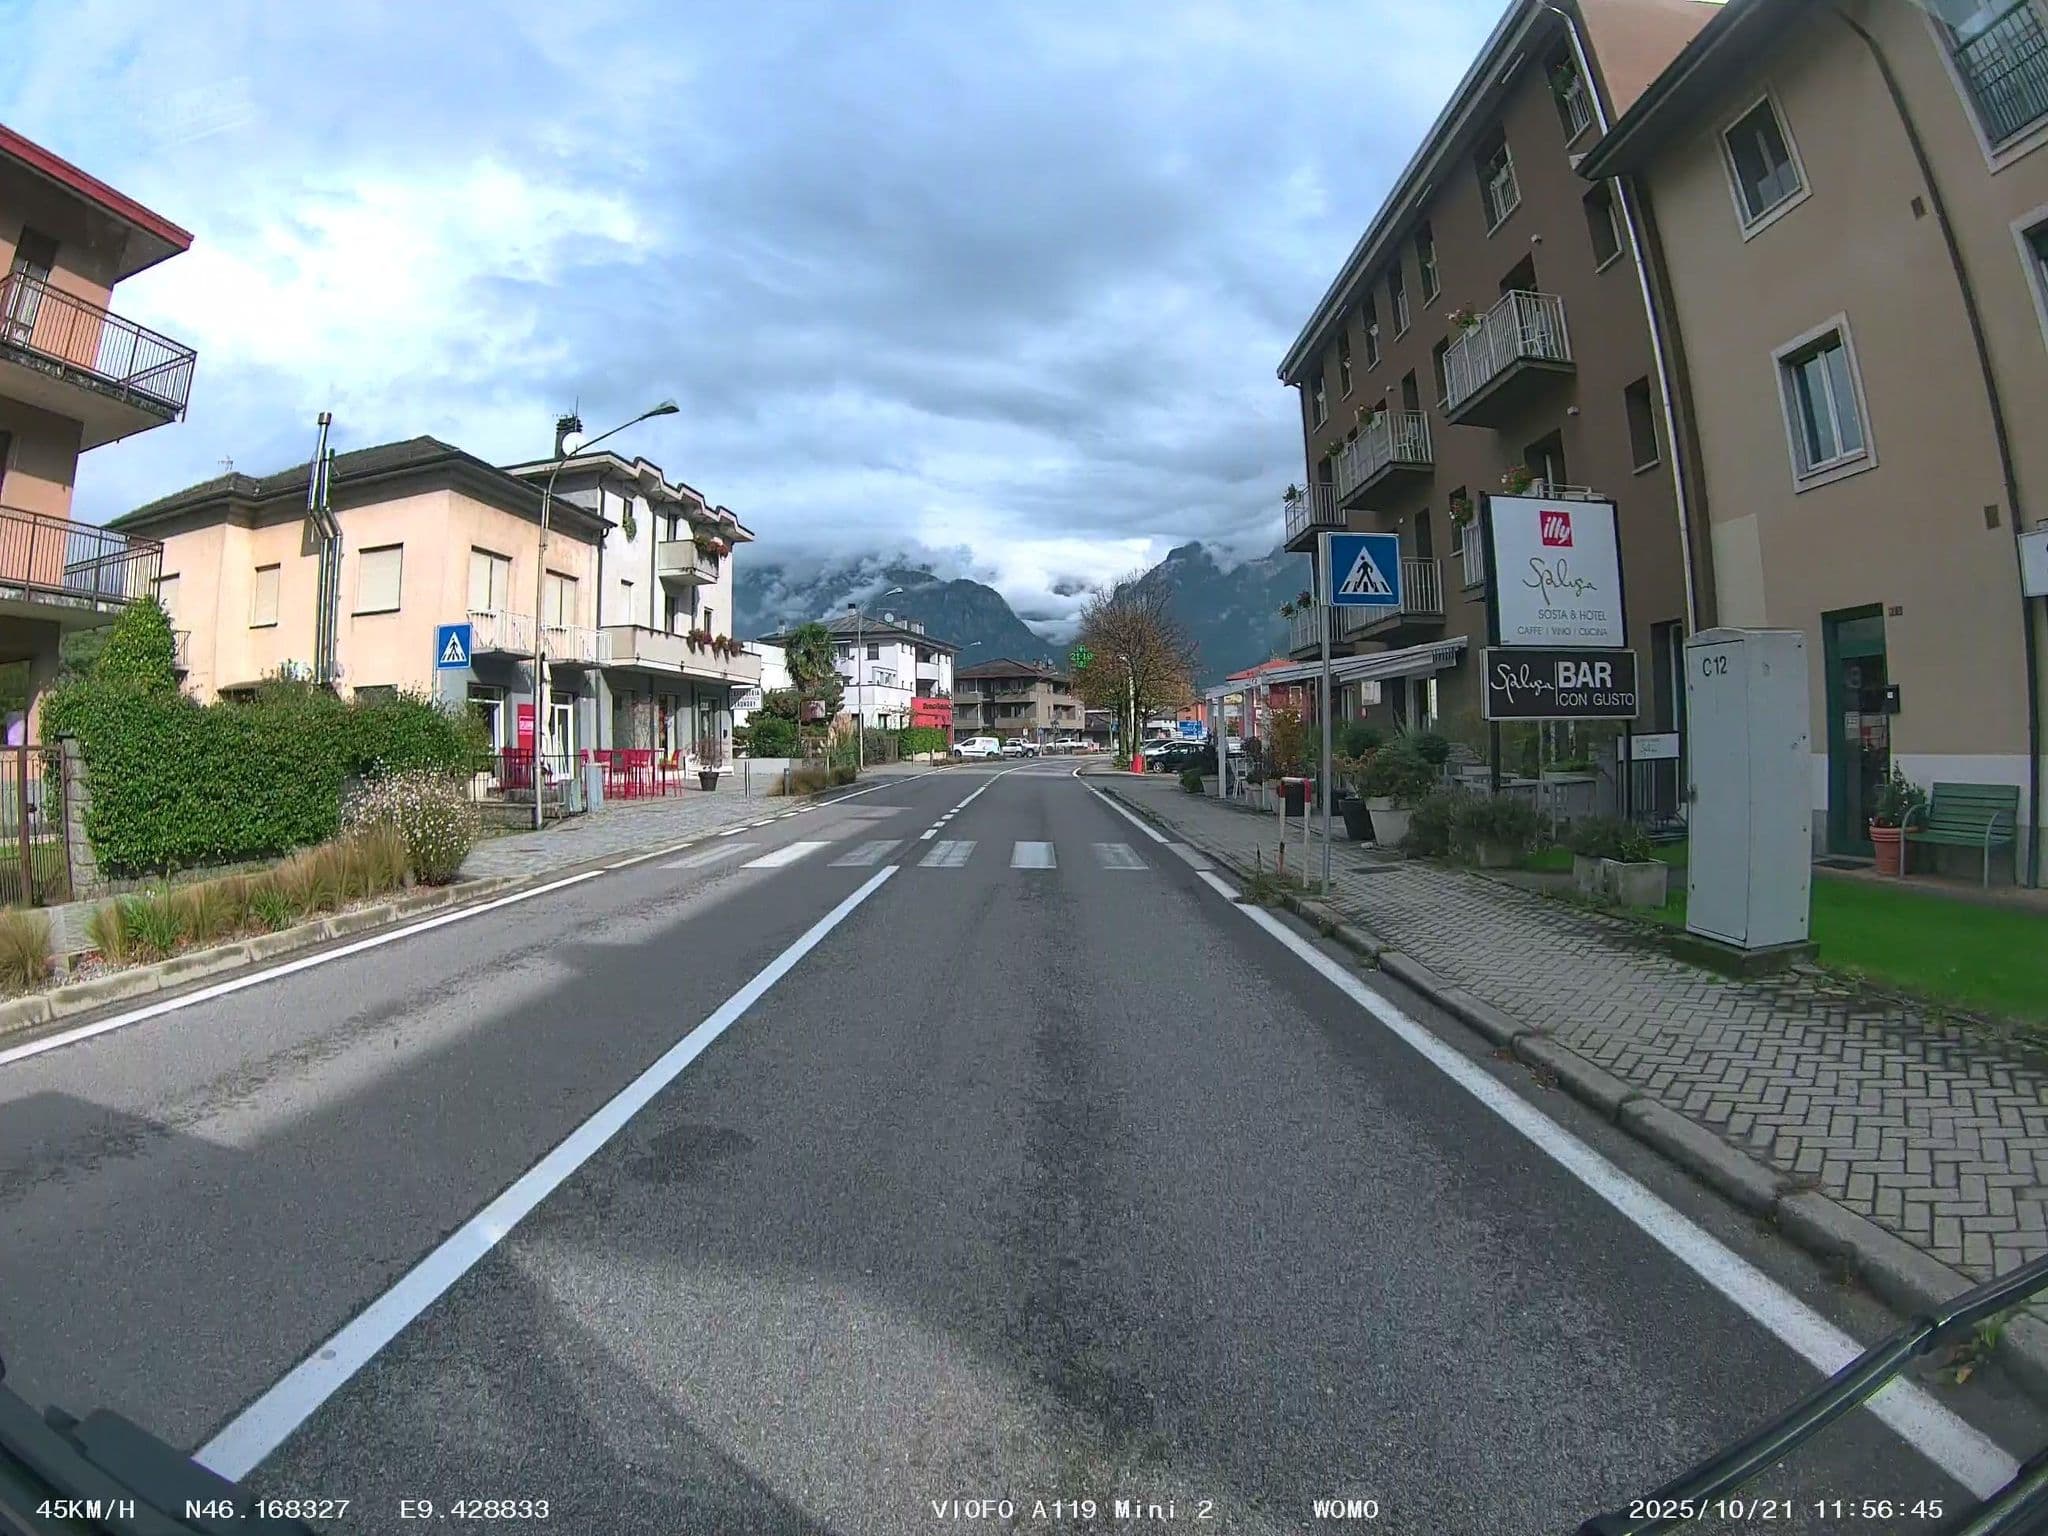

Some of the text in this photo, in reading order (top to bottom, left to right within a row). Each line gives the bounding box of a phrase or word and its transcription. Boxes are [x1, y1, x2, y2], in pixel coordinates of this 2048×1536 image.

[1543, 515, 1571, 544] illy
[1538, 608, 1607, 621] SOSTA & HOTEL
[1551, 626, 1572, 635] VINO
[1578, 627, 1608, 636] CUCINA
[1558, 661, 1612, 688] BAR
[1559, 692, 1635, 707] CON GUSTO
